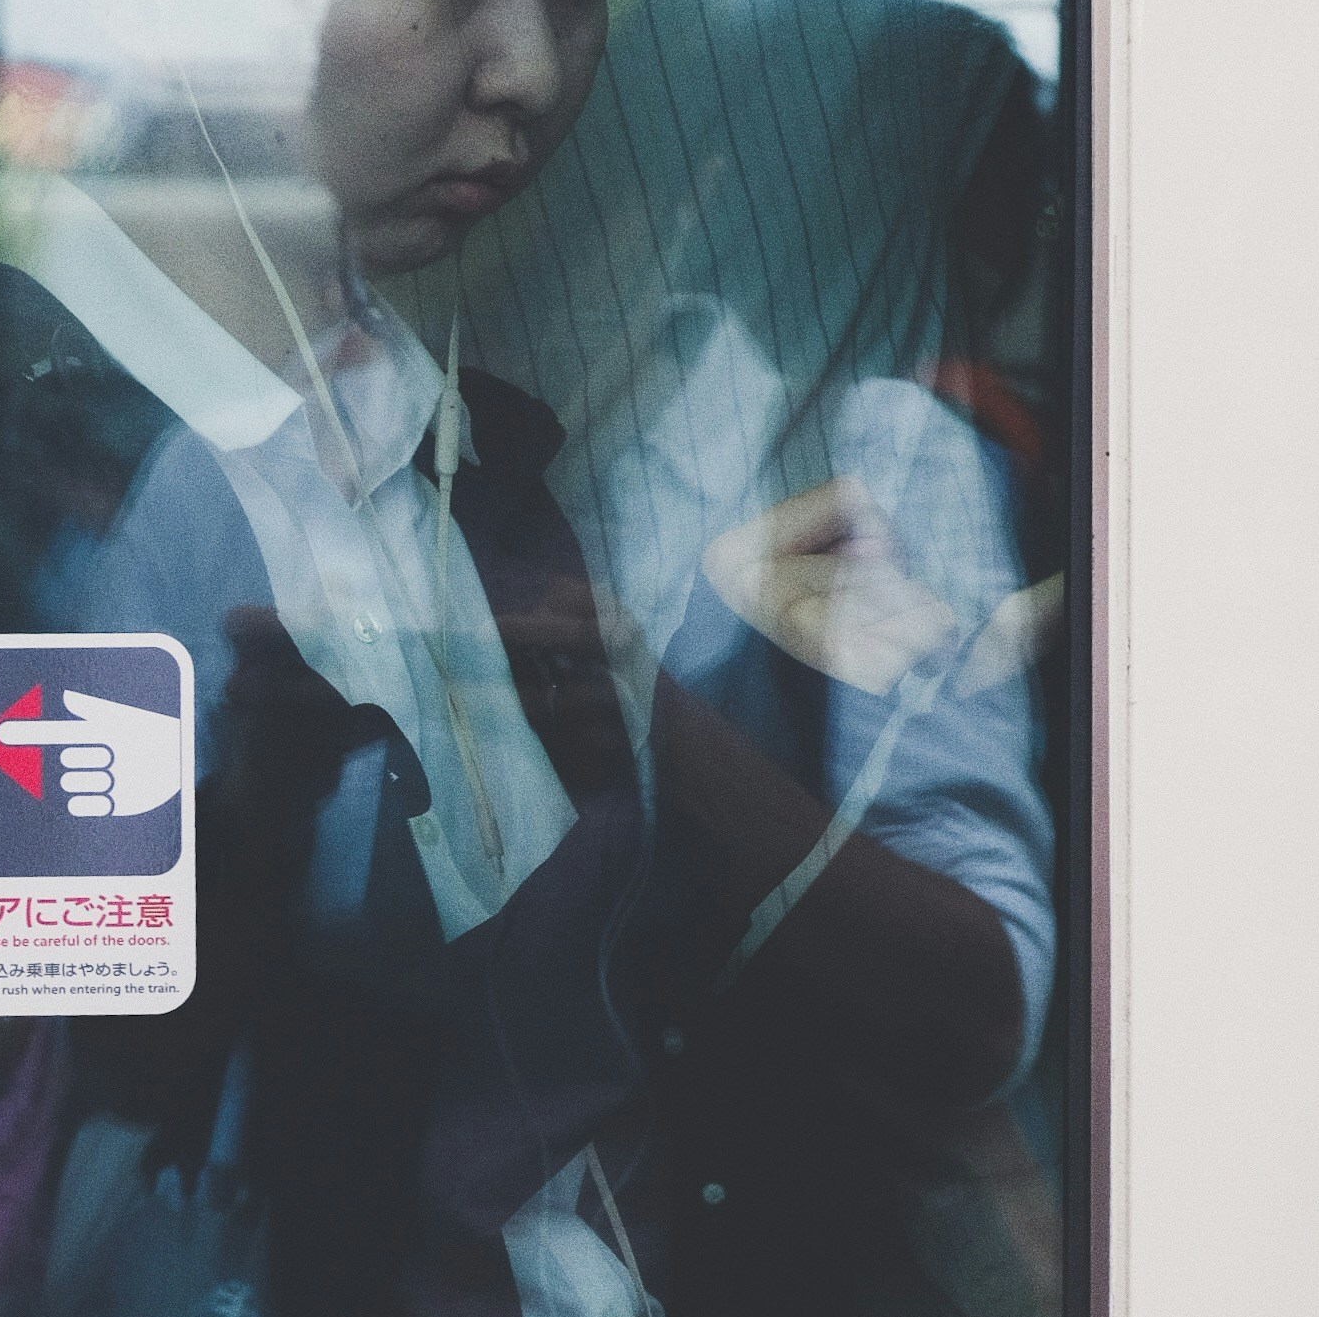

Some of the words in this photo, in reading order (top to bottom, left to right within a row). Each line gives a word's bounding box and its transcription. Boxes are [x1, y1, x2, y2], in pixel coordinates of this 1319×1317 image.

[12, 935, 30, 947] be
[33, 934, 80, 947] careful
[83, 934, 98, 946] of
[101, 934, 124, 946] the
[128, 934, 170, 946] doors.
[2, 984, 28, 995] rush
[31, 984, 66, 995] when
[69, 984, 121, 997] entering
[125, 983, 145, 994] the
[148, 983, 180, 994] train.
